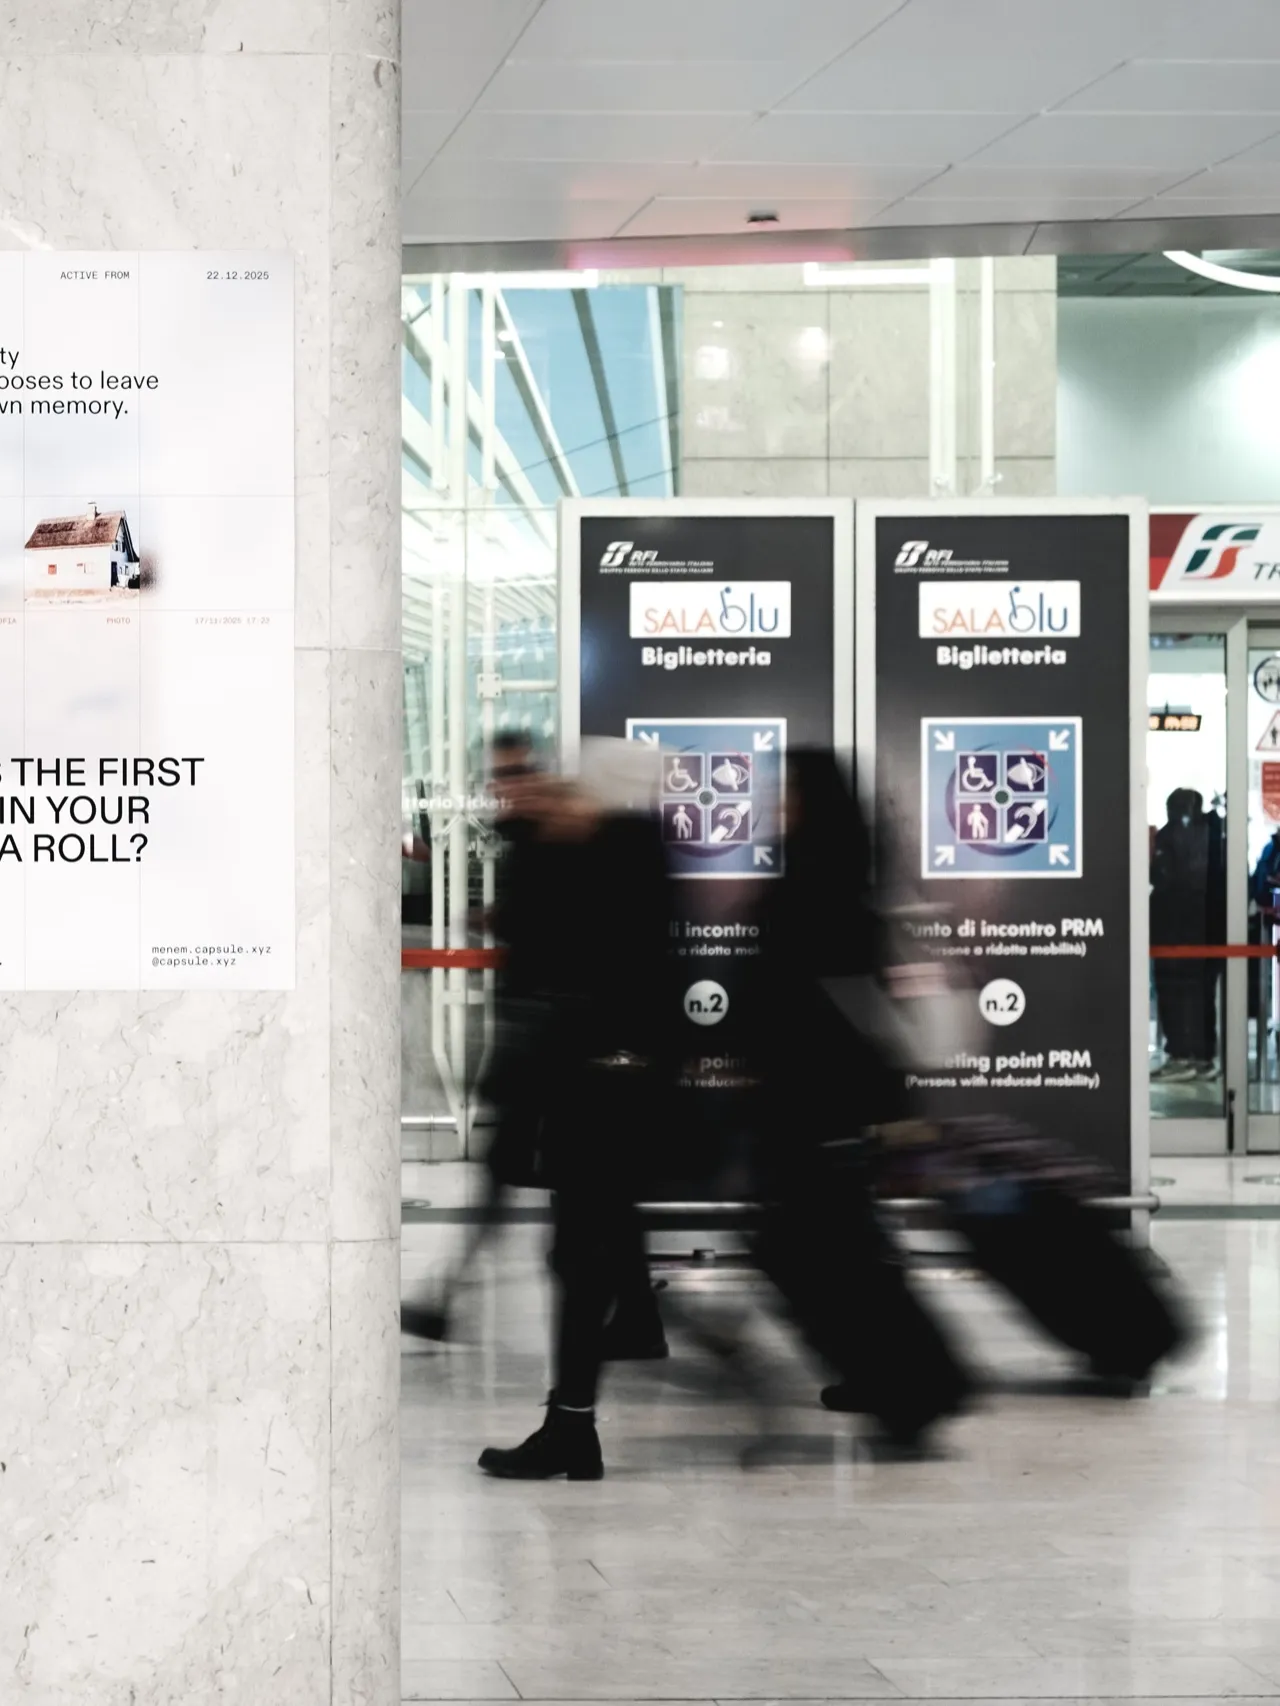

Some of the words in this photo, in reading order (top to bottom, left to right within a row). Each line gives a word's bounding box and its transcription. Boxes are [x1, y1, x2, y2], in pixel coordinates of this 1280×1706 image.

[61, 271, 97, 279] ACTIVE
[105, 271, 129, 279] FROM
[207, 271, 269, 280] 22.12.2025
[71, 372, 92, 389] to
[101, 371, 158, 389] leave
[32, 401, 127, 419] memory.
[644, 607, 717, 634] SALA
[932, 607, 1005, 634] SALA
[642, 646, 772, 670] Biglietteria
[937, 645, 1067, 670] Biglietteria
[11, 758, 85, 786] THE
[100, 757, 204, 786] FIRST
[0, 796, 34, 824] IN
[46, 796, 149, 824] YOUR
[34, 833, 148, 862] ROLL?
[685, 921, 760, 938] incontro
[958, 918, 976, 938] di
[981, 919, 1057, 938] incontro
[1061, 918, 1104, 938] PRM
[152, 944, 270, 957] menem.capsule.xyz
[678, 947, 688, 956] a
[690, 944, 732, 956] ridotta
[974, 946, 984, 956] a
[986, 944, 1028, 956] ridotta
[152, 956, 235, 967] @capsule.xyz
[688, 993, 723, 1013] n.2
[986, 993, 1019, 1013] n.2
[995, 1051, 1044, 1073] point
[1049, 1050, 1092, 1068] PRM
[905, 1074, 957, 1089] (Persons
[960, 1073, 988, 1087] with
[991, 1073, 1042, 1087] reduced
[1044, 1073, 1100, 1090] mobility)
